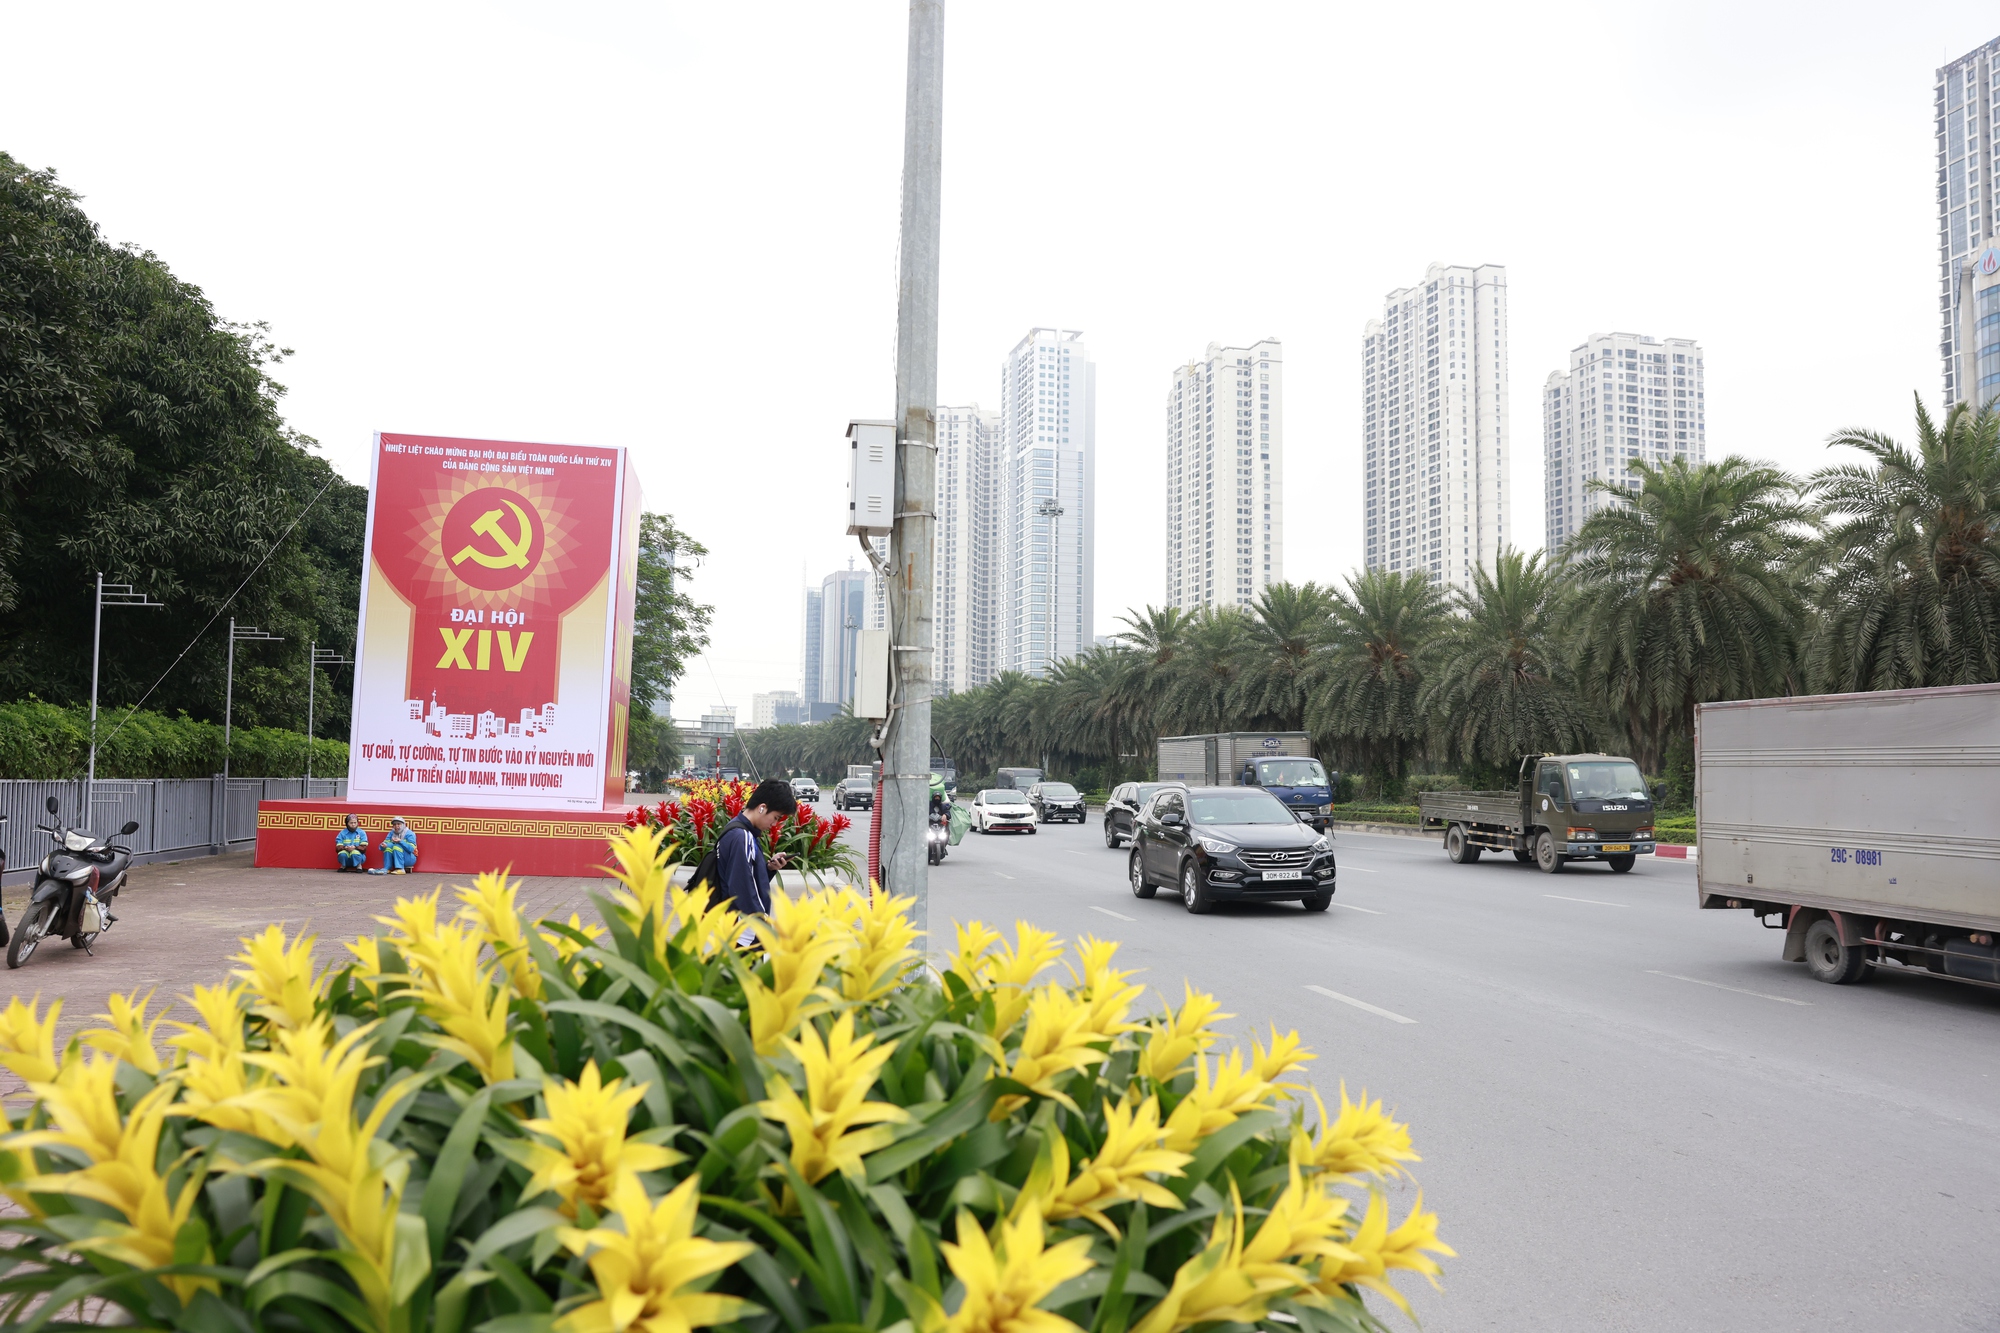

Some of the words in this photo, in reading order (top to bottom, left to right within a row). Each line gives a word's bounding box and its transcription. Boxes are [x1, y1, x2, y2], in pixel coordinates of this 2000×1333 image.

[385, 443, 406, 455] NHIỆT
[408, 444, 423, 455] LIỆT
[424, 445, 443, 456] CHÀO
[445, 446, 467, 457] MỪNG
[468, 449, 481, 460] ĐẠI
[482, 449, 495, 460] HỘI
[496, 451, 508, 461] ĐẠI
[510, 449, 527, 461] BIỂU
[528, 452, 547, 463] TOÀN
[548, 452, 568, 464] QUỐC
[585, 455, 599, 466] THỨ
[600, 458, 612, 467] XIV
[442, 457, 457, 469] CỦA
[458, 459, 479, 471] ĐẢNG
[480, 462, 500, 473] CỘNG
[501, 461, 517, 473] SẢN
[518, 464, 534, 476] VIỆT
[535, 466, 555, 476] NAM!
[450, 608, 484, 626] ĐẠI
[491, 608, 525, 628] HỘI
[435, 627, 535, 672] XIV
[362, 742, 375, 762] TỰ
[375, 738, 396, 761] CHỦ,
[399, 744, 412, 763] TỰ
[412, 742, 446, 763] CƯỜNG,
[448, 746, 461, 765] TỰ
[462, 748, 477, 763] TIN
[478, 745, 503, 764] BƯỚC
[505, 747, 523, 765] VÀO
[524, 744, 537, 765] KỶ
[538, 749, 575, 767] NGUYÊN
[576, 749, 594, 768] MỚI
[391, 765, 415, 783] PHÁT
[416, 763, 443, 784] TRIỂN
[445, 767, 467, 785] GIÀU
[468, 770, 498, 788] MẠNH,
[501, 771, 527, 790] THỊNH
[529, 771, 563, 791] VƯỢNG!
[1830, 848, 1847, 863] 29C
[1855, 849, 1882, 866] 08981
